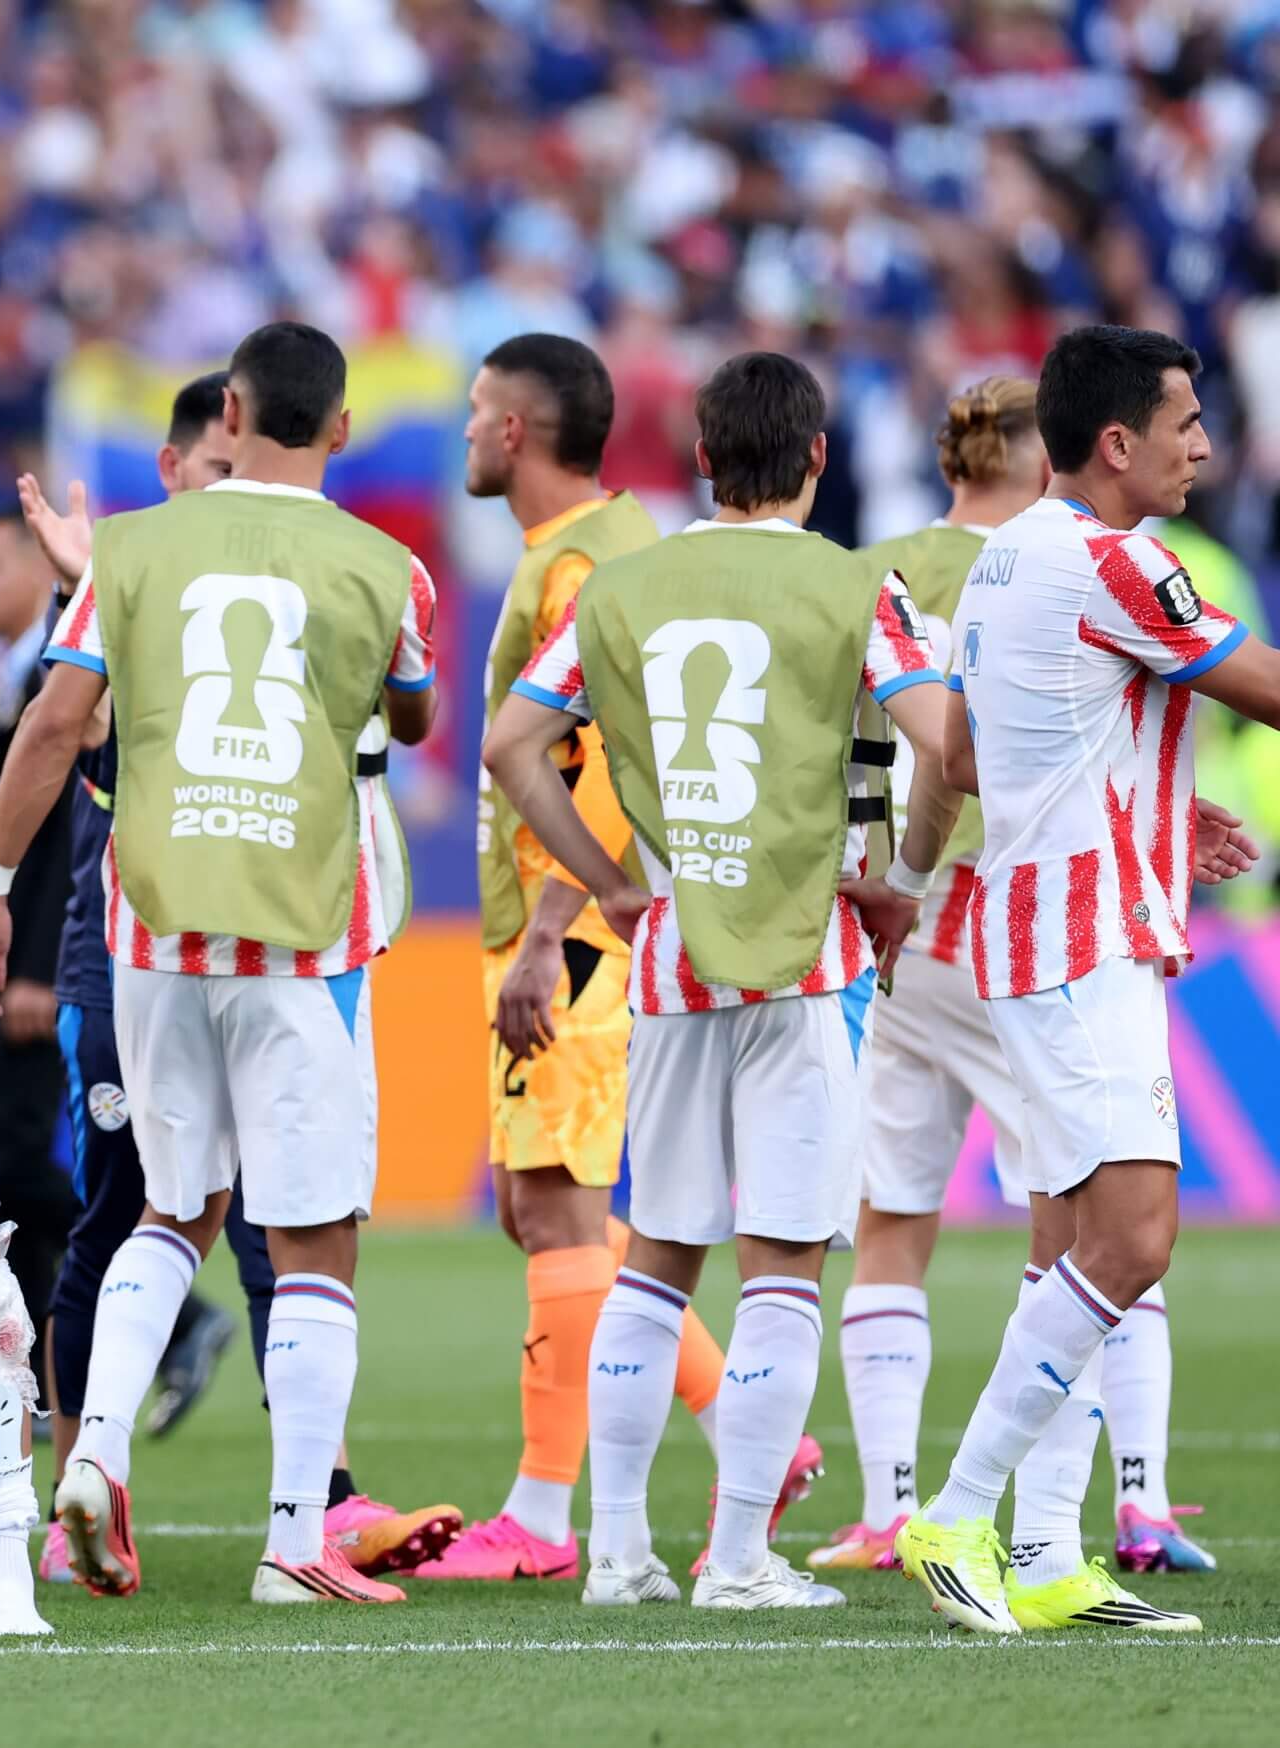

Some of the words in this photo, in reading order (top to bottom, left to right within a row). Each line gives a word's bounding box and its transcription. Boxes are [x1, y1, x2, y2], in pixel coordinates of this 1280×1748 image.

[213, 736, 271, 762] FIFA
[173, 785, 257, 806] WORLD
[259, 792, 299, 815] CUP
[663, 780, 719, 803] FIFA
[171, 807, 297, 849] 2026
[703, 832, 752, 853] CUP
[596, 1361, 646, 1377] APF
[726, 1365, 775, 1385] APF
